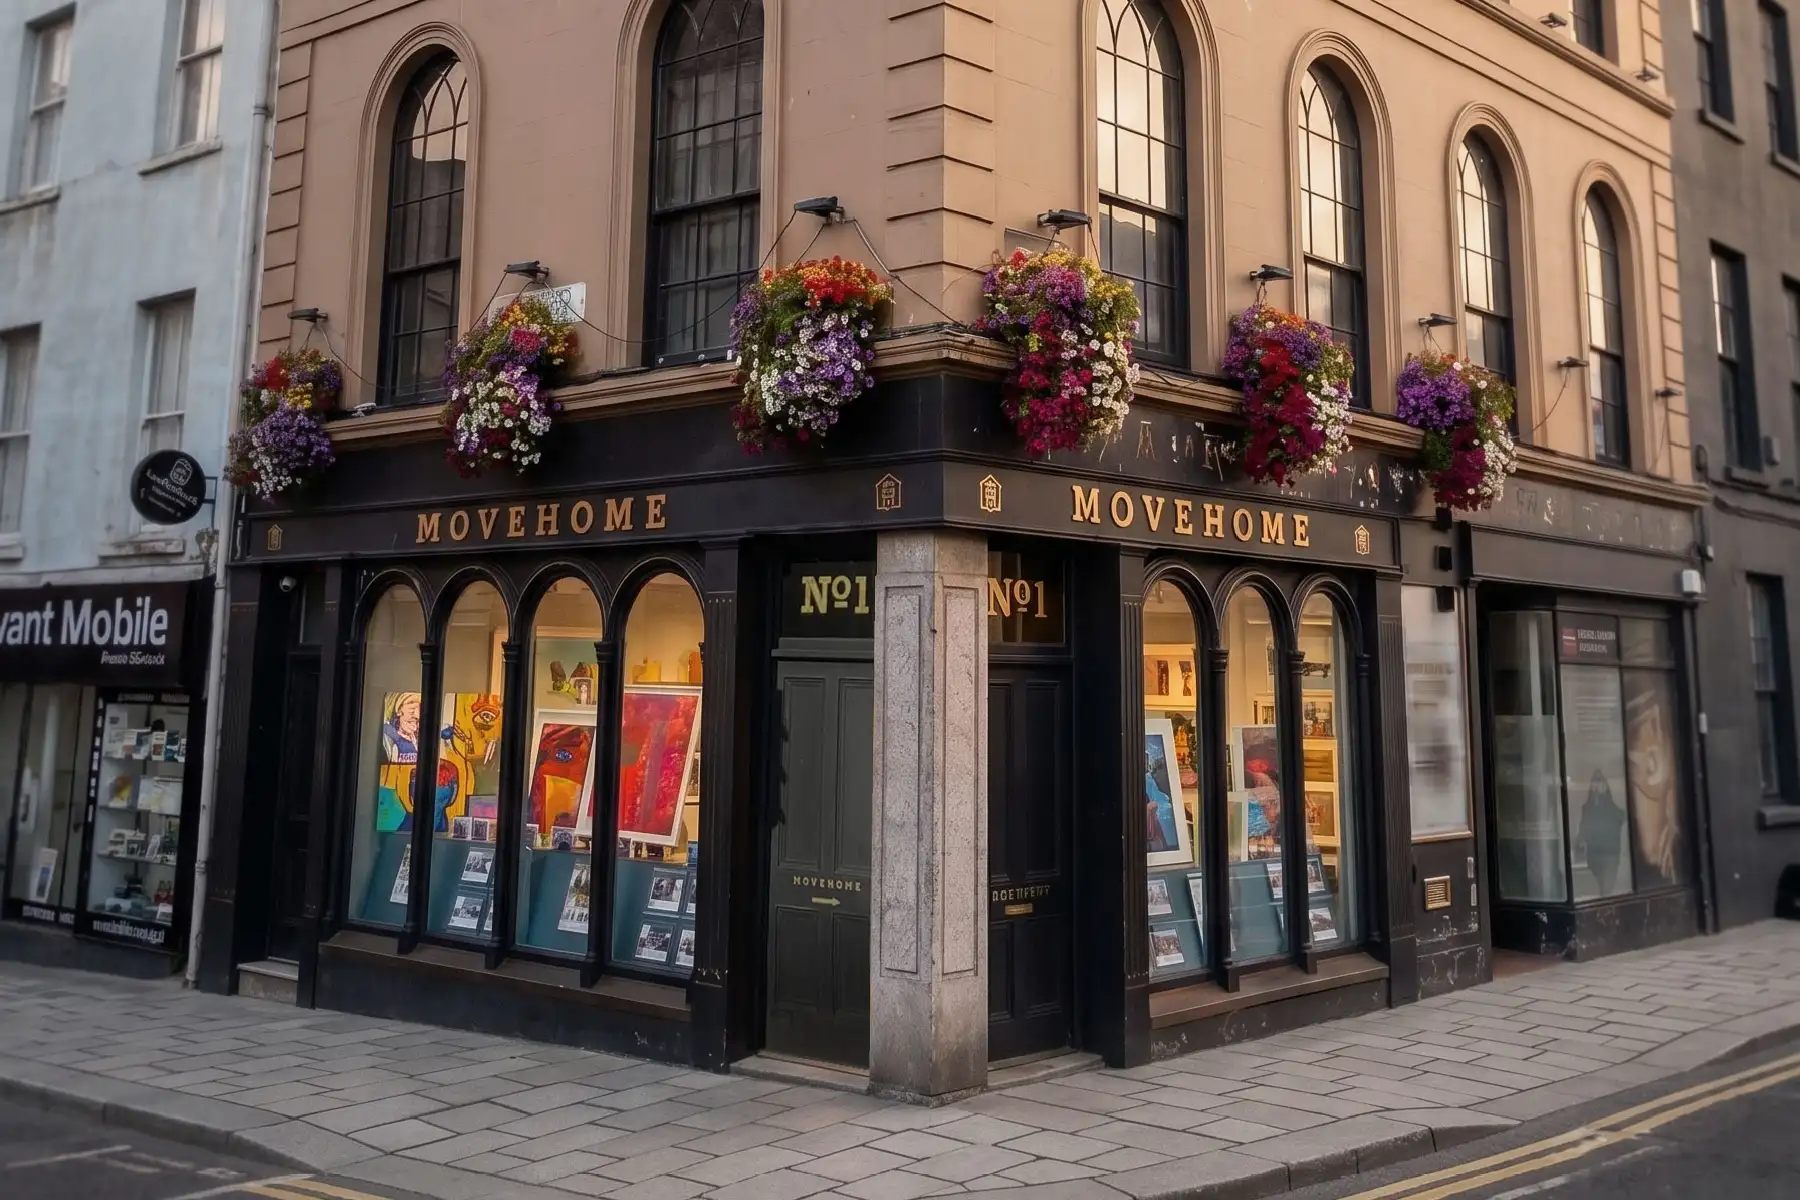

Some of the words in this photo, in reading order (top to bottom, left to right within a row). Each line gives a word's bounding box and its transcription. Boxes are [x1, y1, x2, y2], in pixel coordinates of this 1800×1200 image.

[416, 494, 667, 544] MOVEHOME
[1071, 485, 1310, 547] MOVEHOME
[60, 595, 169, 646] Mobile
[793, 875, 861, 892] MOVEHOME
